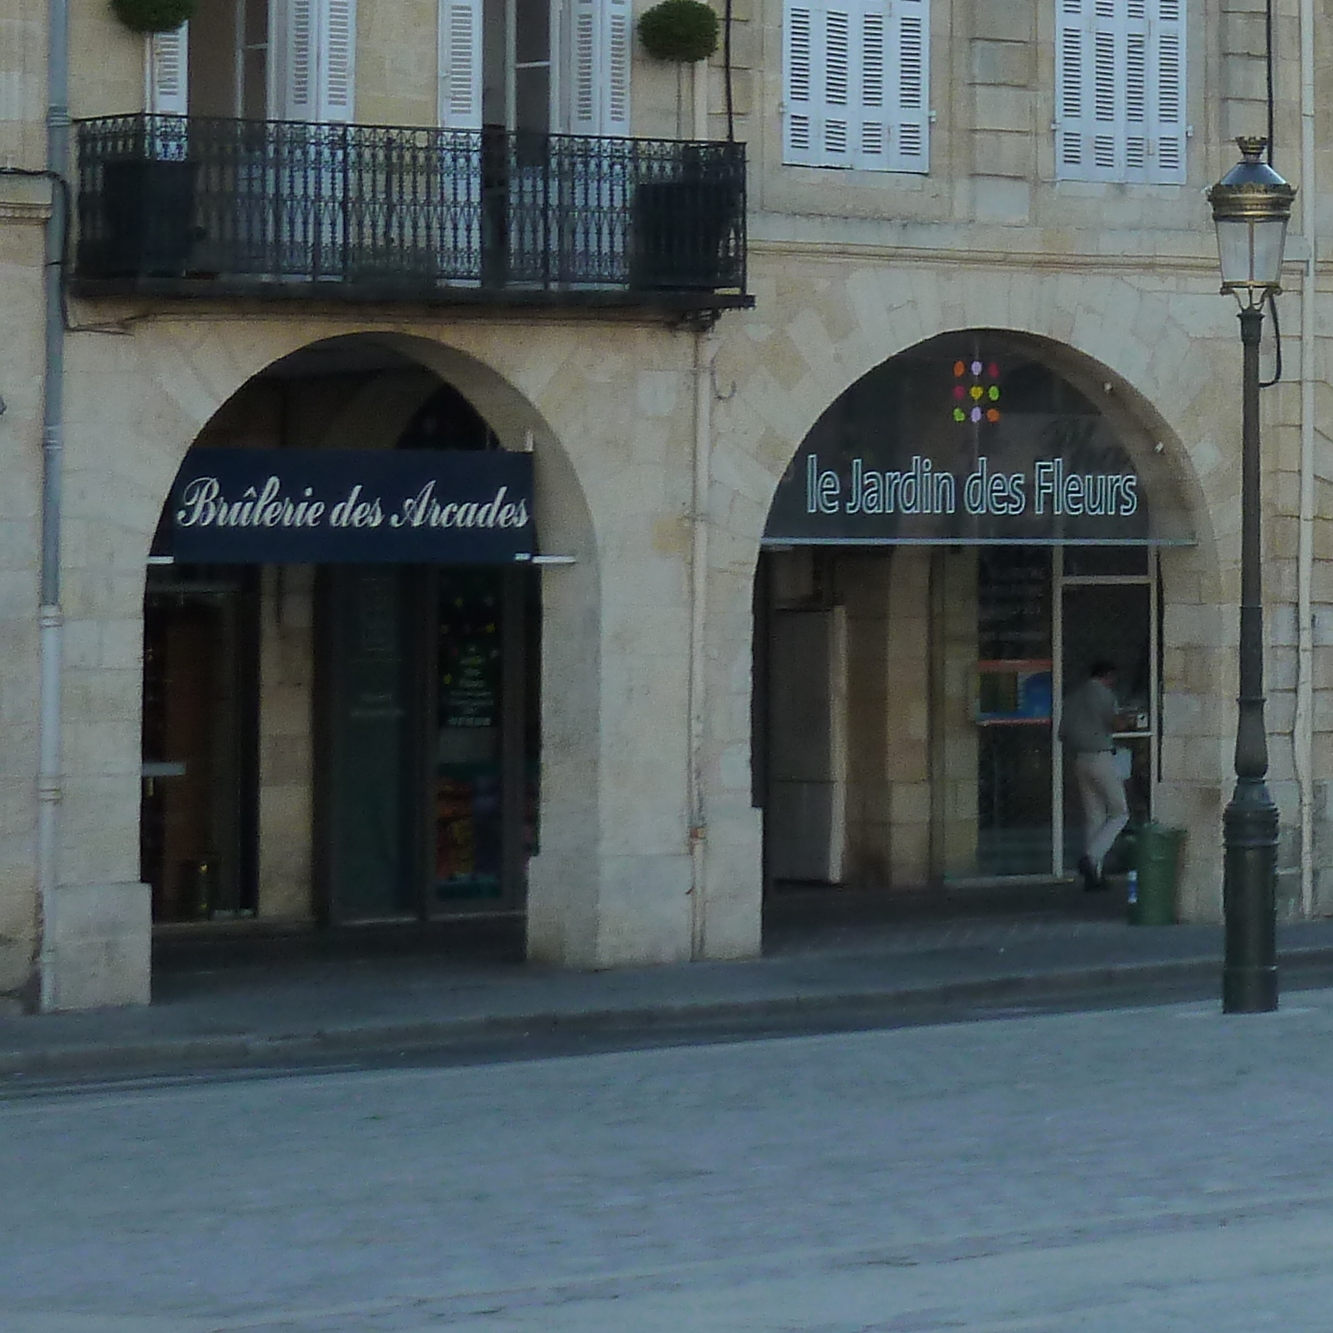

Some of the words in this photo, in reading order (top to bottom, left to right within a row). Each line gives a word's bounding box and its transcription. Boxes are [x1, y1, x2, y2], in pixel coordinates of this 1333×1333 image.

[177, 475, 325, 528] Brûlerie
[330, 484, 385, 528] des
[391, 479, 530, 529] Arcades
[806, 454, 841, 514] le
[845, 455, 956, 514] Jardin
[963, 456, 1026, 515] des
[1034, 457, 1138, 516] Fleurs
